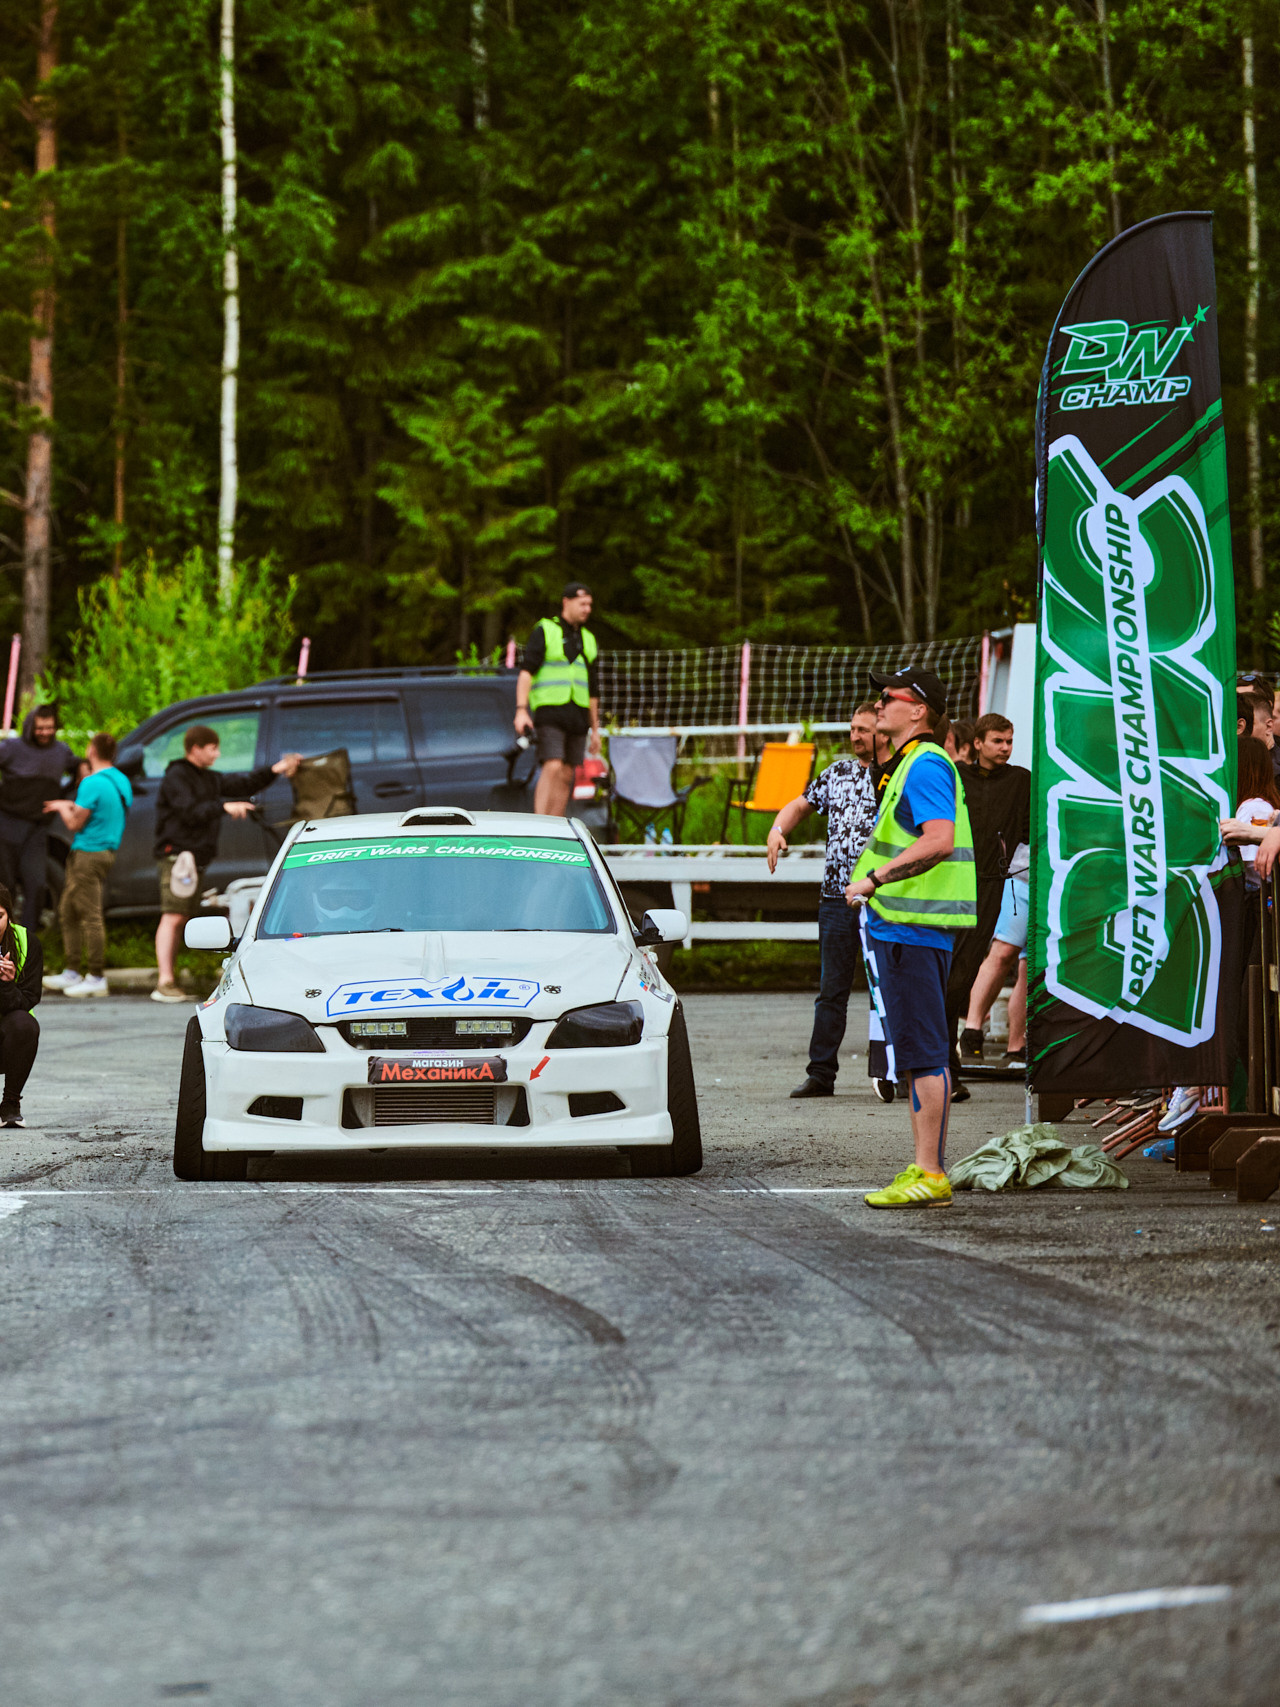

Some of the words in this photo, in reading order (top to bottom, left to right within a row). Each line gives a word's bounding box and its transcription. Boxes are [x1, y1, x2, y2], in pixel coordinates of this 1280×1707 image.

[1059, 319, 1192, 382] DW
[1060, 376, 1192, 411] CHAMP
[1104, 503, 1152, 786] CHAMPIONSHIP
[306, 849, 367, 863] DRIFT
[370, 846, 427, 856] WARS
[434, 846, 586, 864] CHAMPIONSHIP
[1130, 794, 1158, 897] WARS
[381, 1062, 495, 1081] МеханикА
[412, 1059, 464, 1068] магазин
